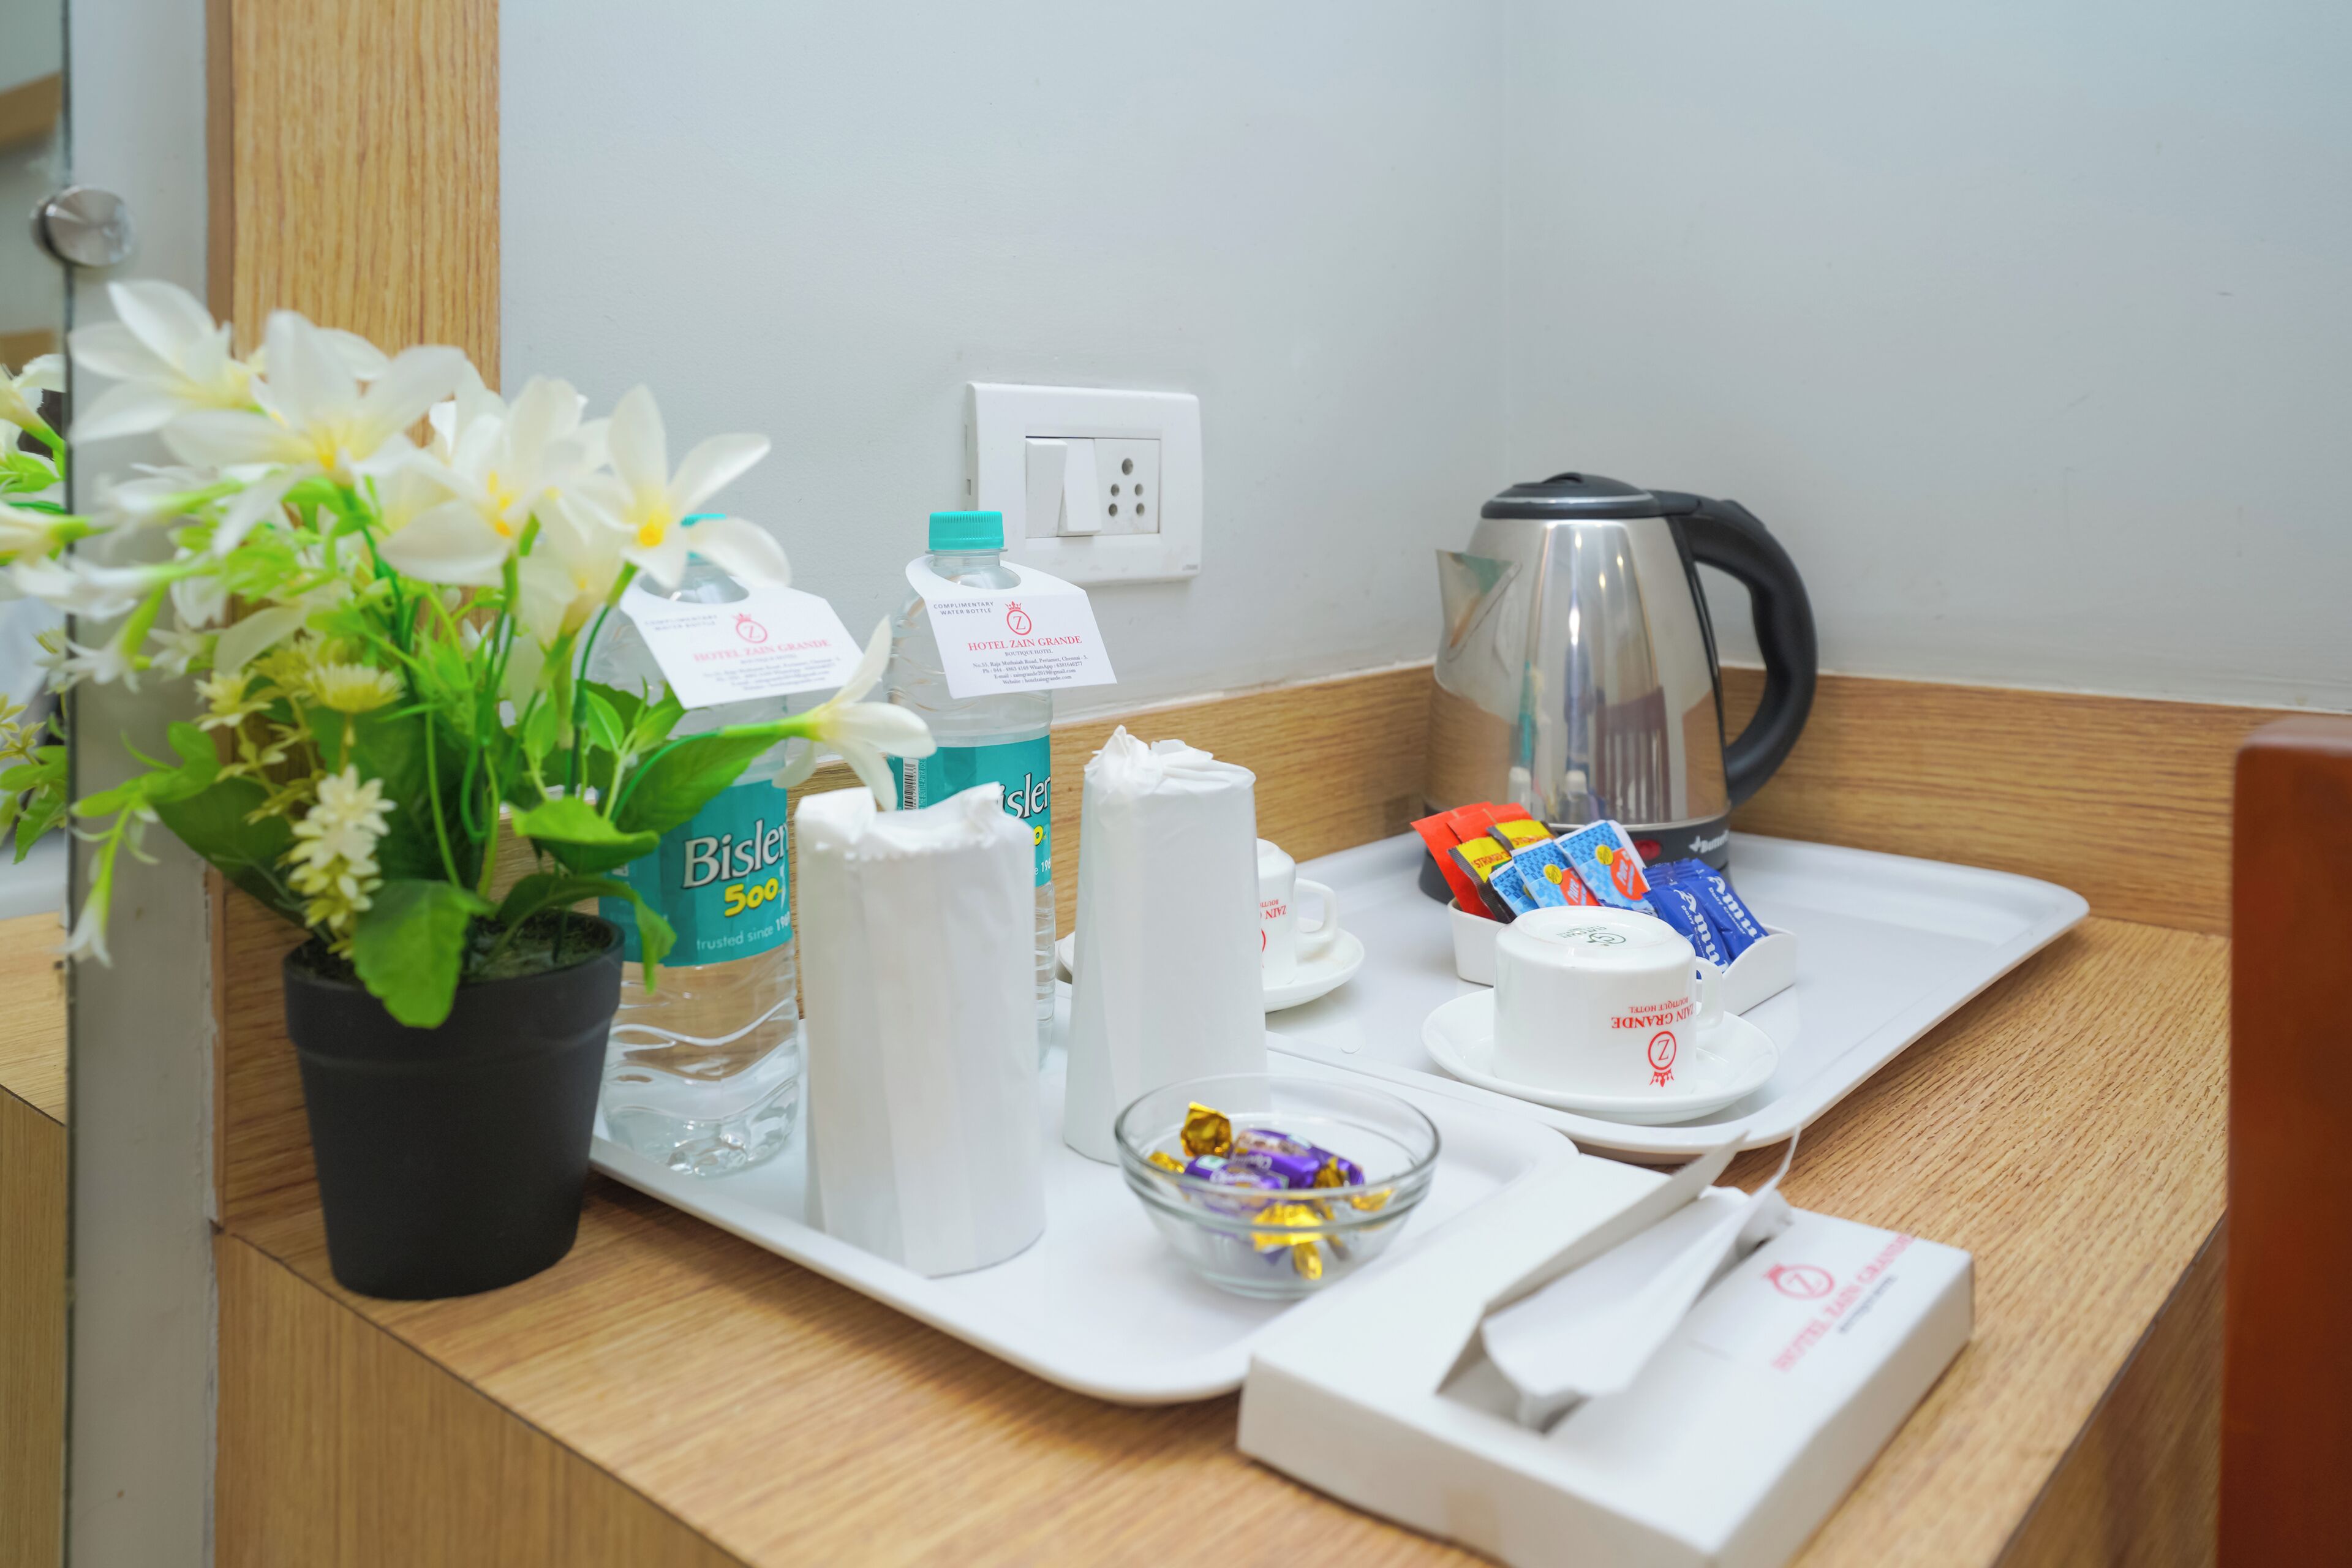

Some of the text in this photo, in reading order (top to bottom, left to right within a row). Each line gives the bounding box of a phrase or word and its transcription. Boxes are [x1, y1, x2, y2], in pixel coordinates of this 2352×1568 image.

[1013, 616, 1026, 630] Z
[967, 636, 1083, 651] HOTEL ZAIN GRANDE
[999, 772, 1050, 819] isler
[1041, 858, 1051, 873] 196
[724, 877, 779, 918] 500
[1260, 899, 1279, 908] BOUTI
[1708, 887, 1724, 905] Dairy
[1264, 904, 1287, 920] ZAIN
[1681, 905, 1695, 925] Dairy
[696, 930, 744, 951] trusted
[747, 925, 774, 942] since
[1629, 997, 1689, 1014] BOUTIQUE HOTEL
[1611, 1003, 1694, 1029] ZAIN GRANDE
[1657, 1038, 1670, 1061] Z
